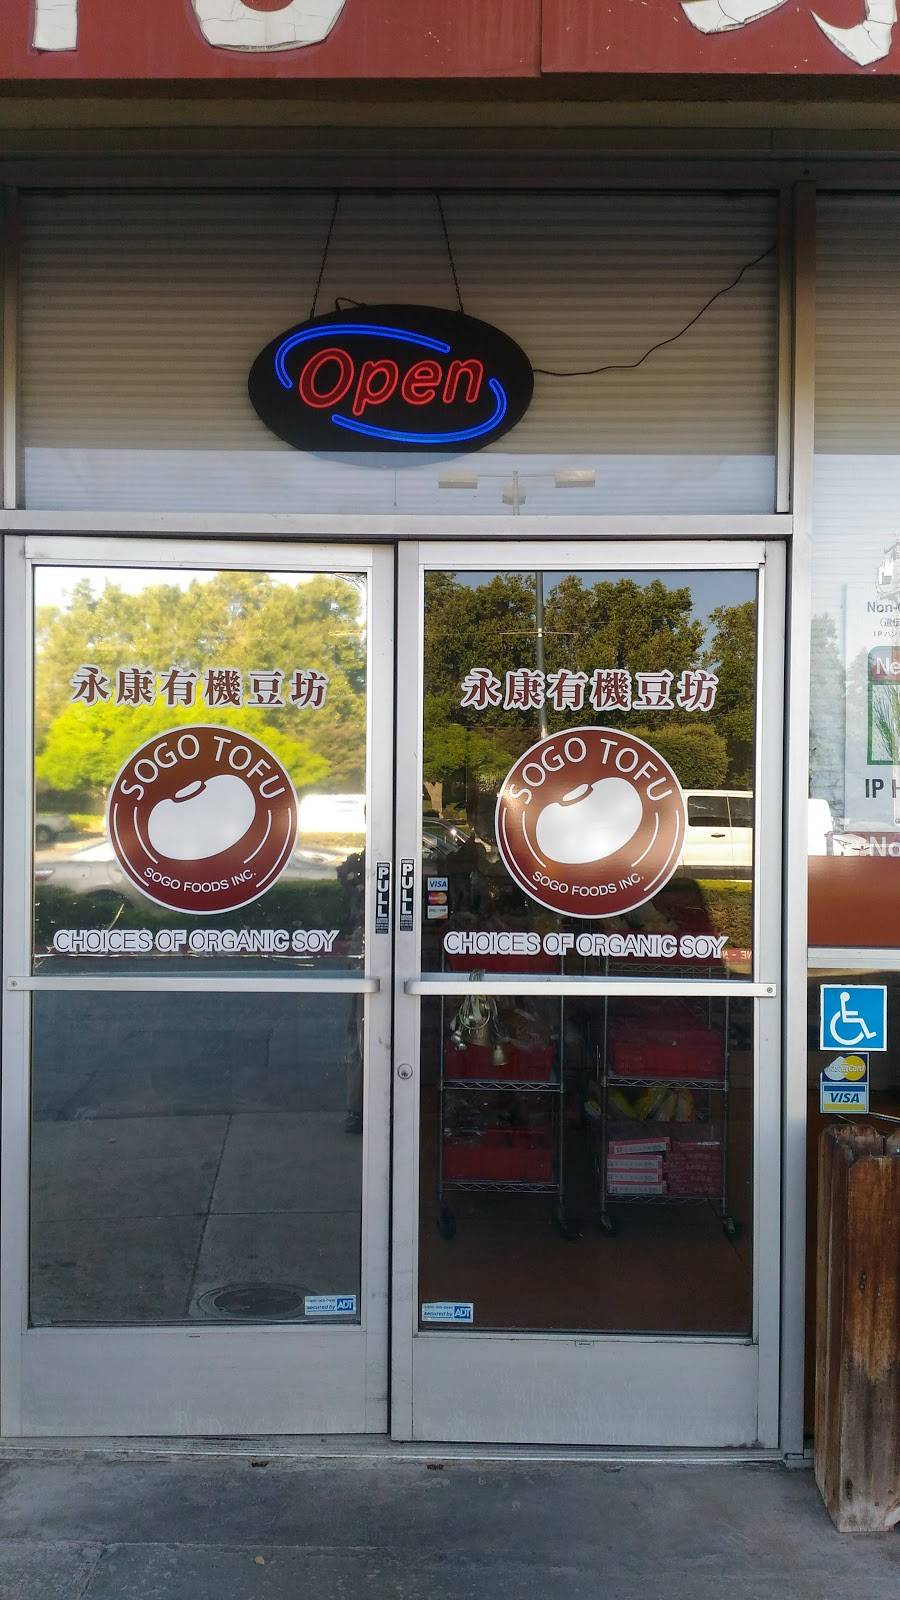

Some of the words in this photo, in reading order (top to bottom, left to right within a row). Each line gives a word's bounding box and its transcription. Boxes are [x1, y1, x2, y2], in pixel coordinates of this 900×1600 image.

[299, 347, 484, 416] Open
[867, 601, 900, 613] Non-
[71, 666, 328, 708] 永康有機豆坊
[461, 668, 718, 711] 永康有機豆坊
[120, 734, 200, 801] SOGO
[213, 735, 286, 800] TOFU
[509, 737, 587, 805] SOGO
[600, 738, 673, 801] TOFU
[865, 778, 884, 798] IP
[144, 867, 181, 890] SOGO
[183, 880, 229, 893] FOODS
[231, 868, 257, 887] INC.
[377, 867, 389, 917] PULL
[401, 864, 413, 914] PULL
[429, 880, 447, 888] VISA
[532, 871, 569, 894] SOGO
[571, 884, 617, 897] FOODS
[618, 872, 645, 890] INC.
[53, 929, 152, 952] CHOICES
[155, 929, 187, 952] OF
[188, 929, 290, 952] ORGANIC
[291, 929, 340, 952] SOY
[443, 931, 541, 955] CHOICES
[543, 932, 574, 956] OF
[575, 933, 678, 957] ORGANIC
[679, 935, 728, 958] SOY
[830, 1092, 860, 1103] VISA
[337, 1299, 354, 1309] ADT
[454, 1307, 471, 1317] ADT
